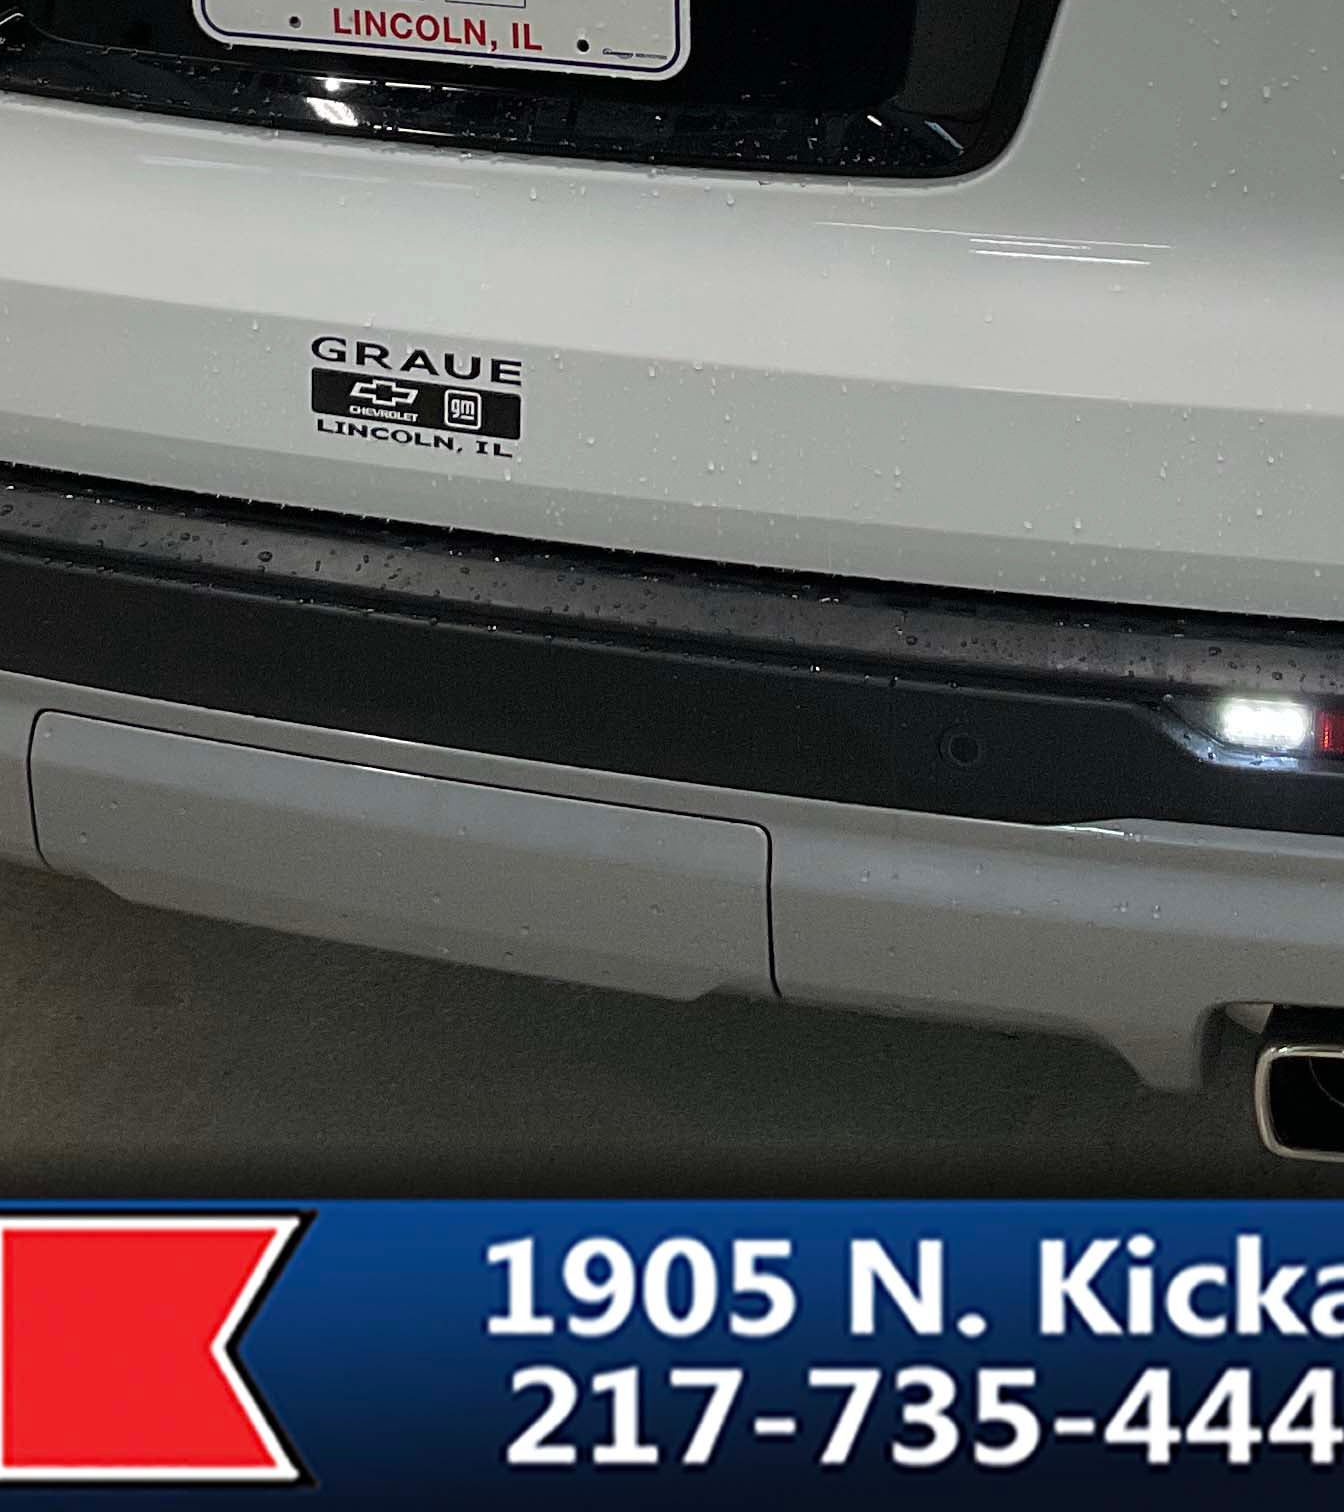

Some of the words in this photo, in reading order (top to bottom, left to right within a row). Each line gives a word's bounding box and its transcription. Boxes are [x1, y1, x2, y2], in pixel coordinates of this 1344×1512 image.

[332, 7, 498, 53] LINCOLN,
[512, 22, 543, 51] IL
[311, 336, 522, 386] GRAUE
[349, 404, 419, 423] CHEVROLET
[451, 397, 475, 420] gm
[317, 419, 464, 454] LINCOLN,
[476, 440, 513, 458] IL
